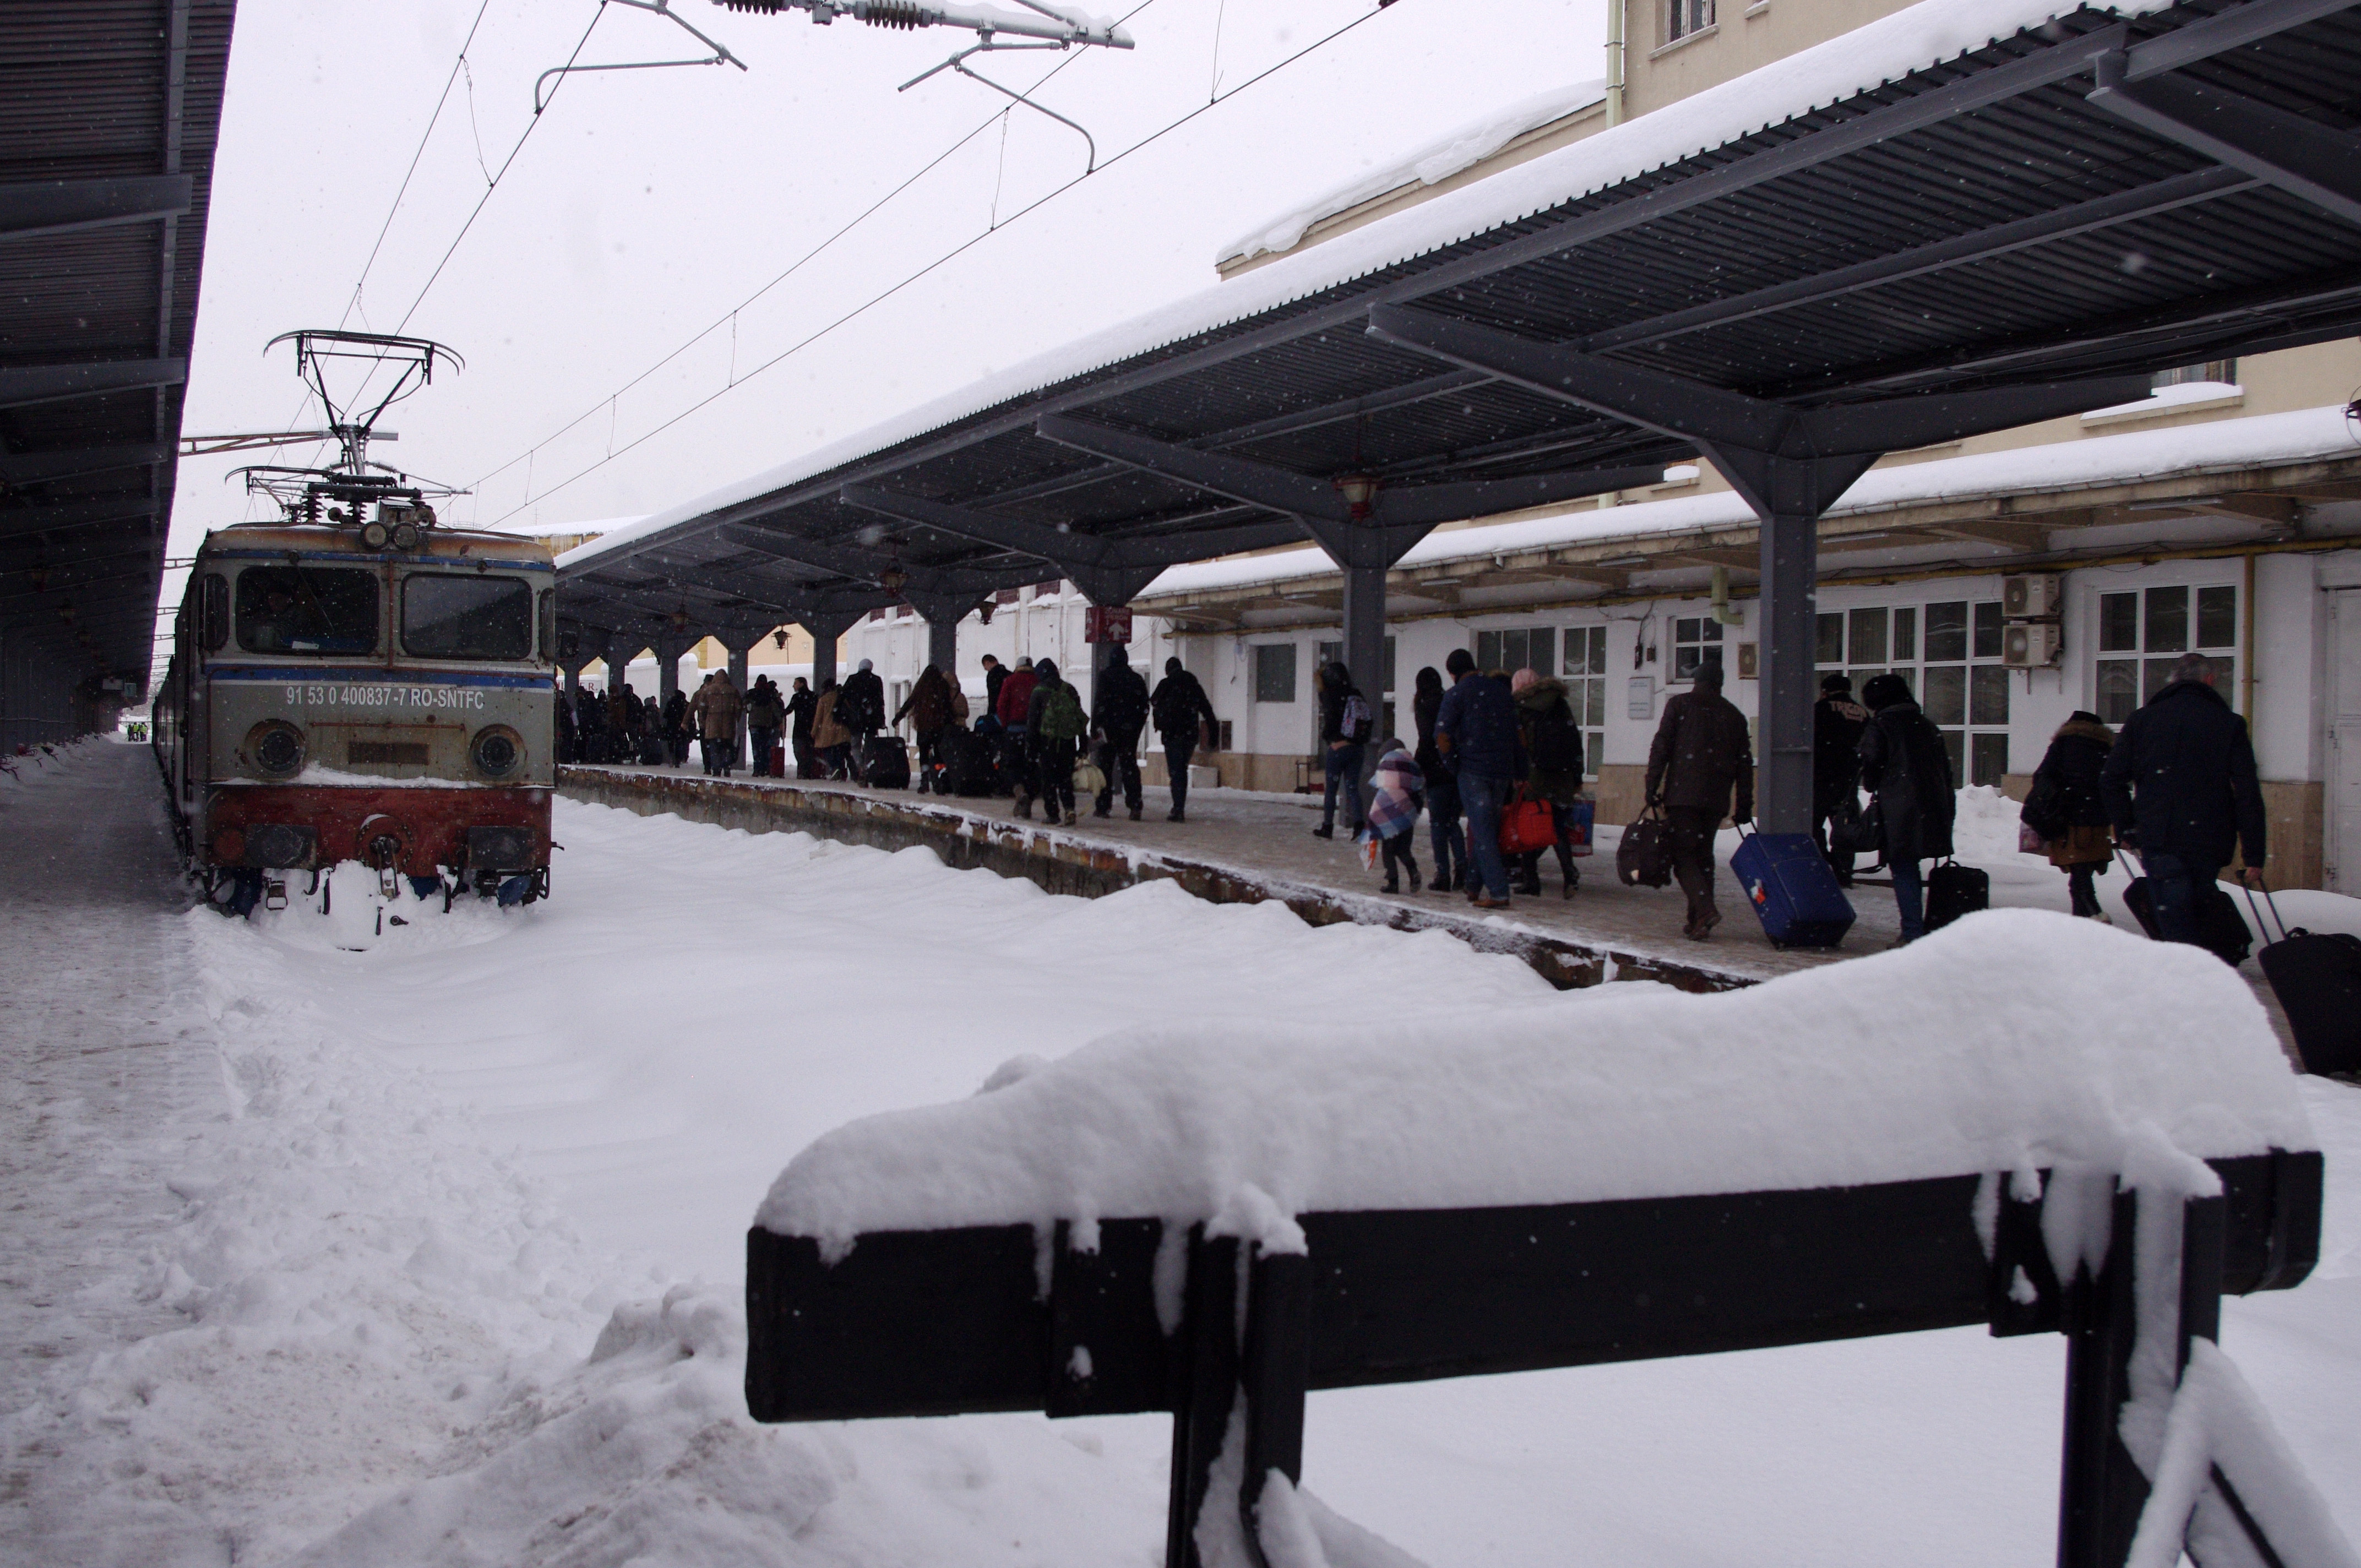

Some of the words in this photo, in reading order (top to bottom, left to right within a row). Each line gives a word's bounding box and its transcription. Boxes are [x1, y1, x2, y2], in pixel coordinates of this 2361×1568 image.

[287, 687, 301, 705] 91
[308, 687, 324, 705] 53
[329, 687, 336, 705] 0
[411, 689, 484, 709] RO-SNTFC
